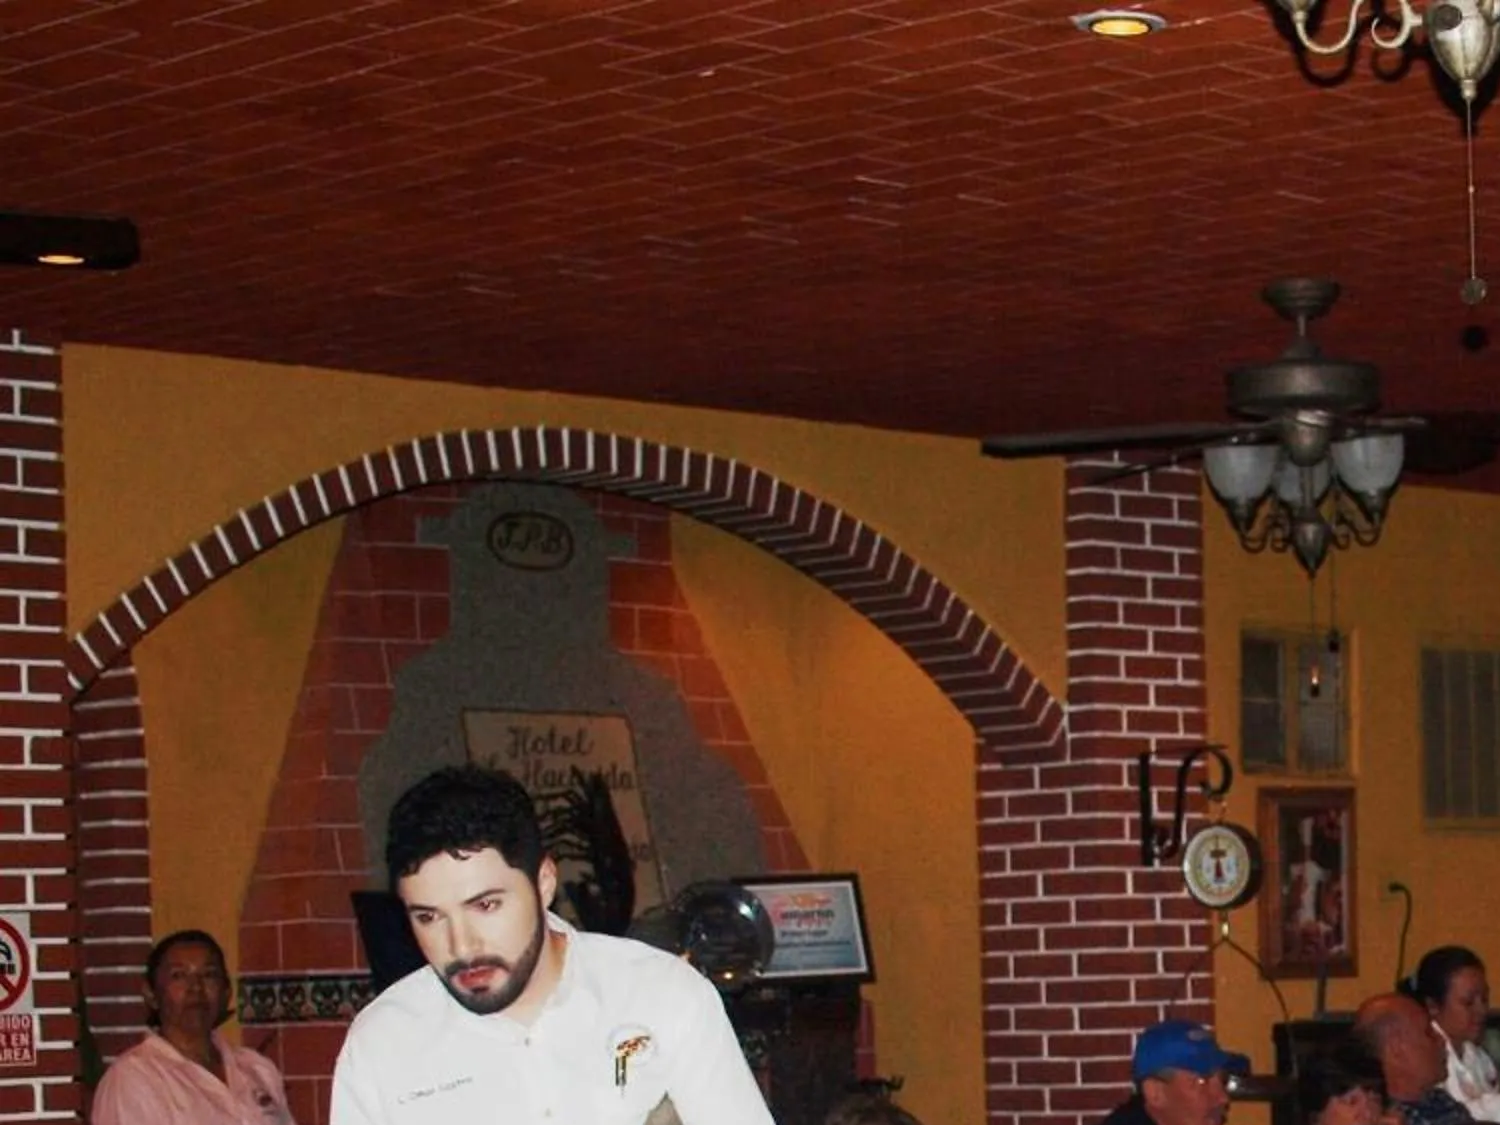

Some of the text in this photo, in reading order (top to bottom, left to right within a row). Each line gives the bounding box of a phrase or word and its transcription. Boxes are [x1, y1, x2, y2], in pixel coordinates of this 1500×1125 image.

[506, 725, 594, 759] Hotel
[522, 759, 636, 791] Hacda
[11, 1033, 29, 1046] EN
